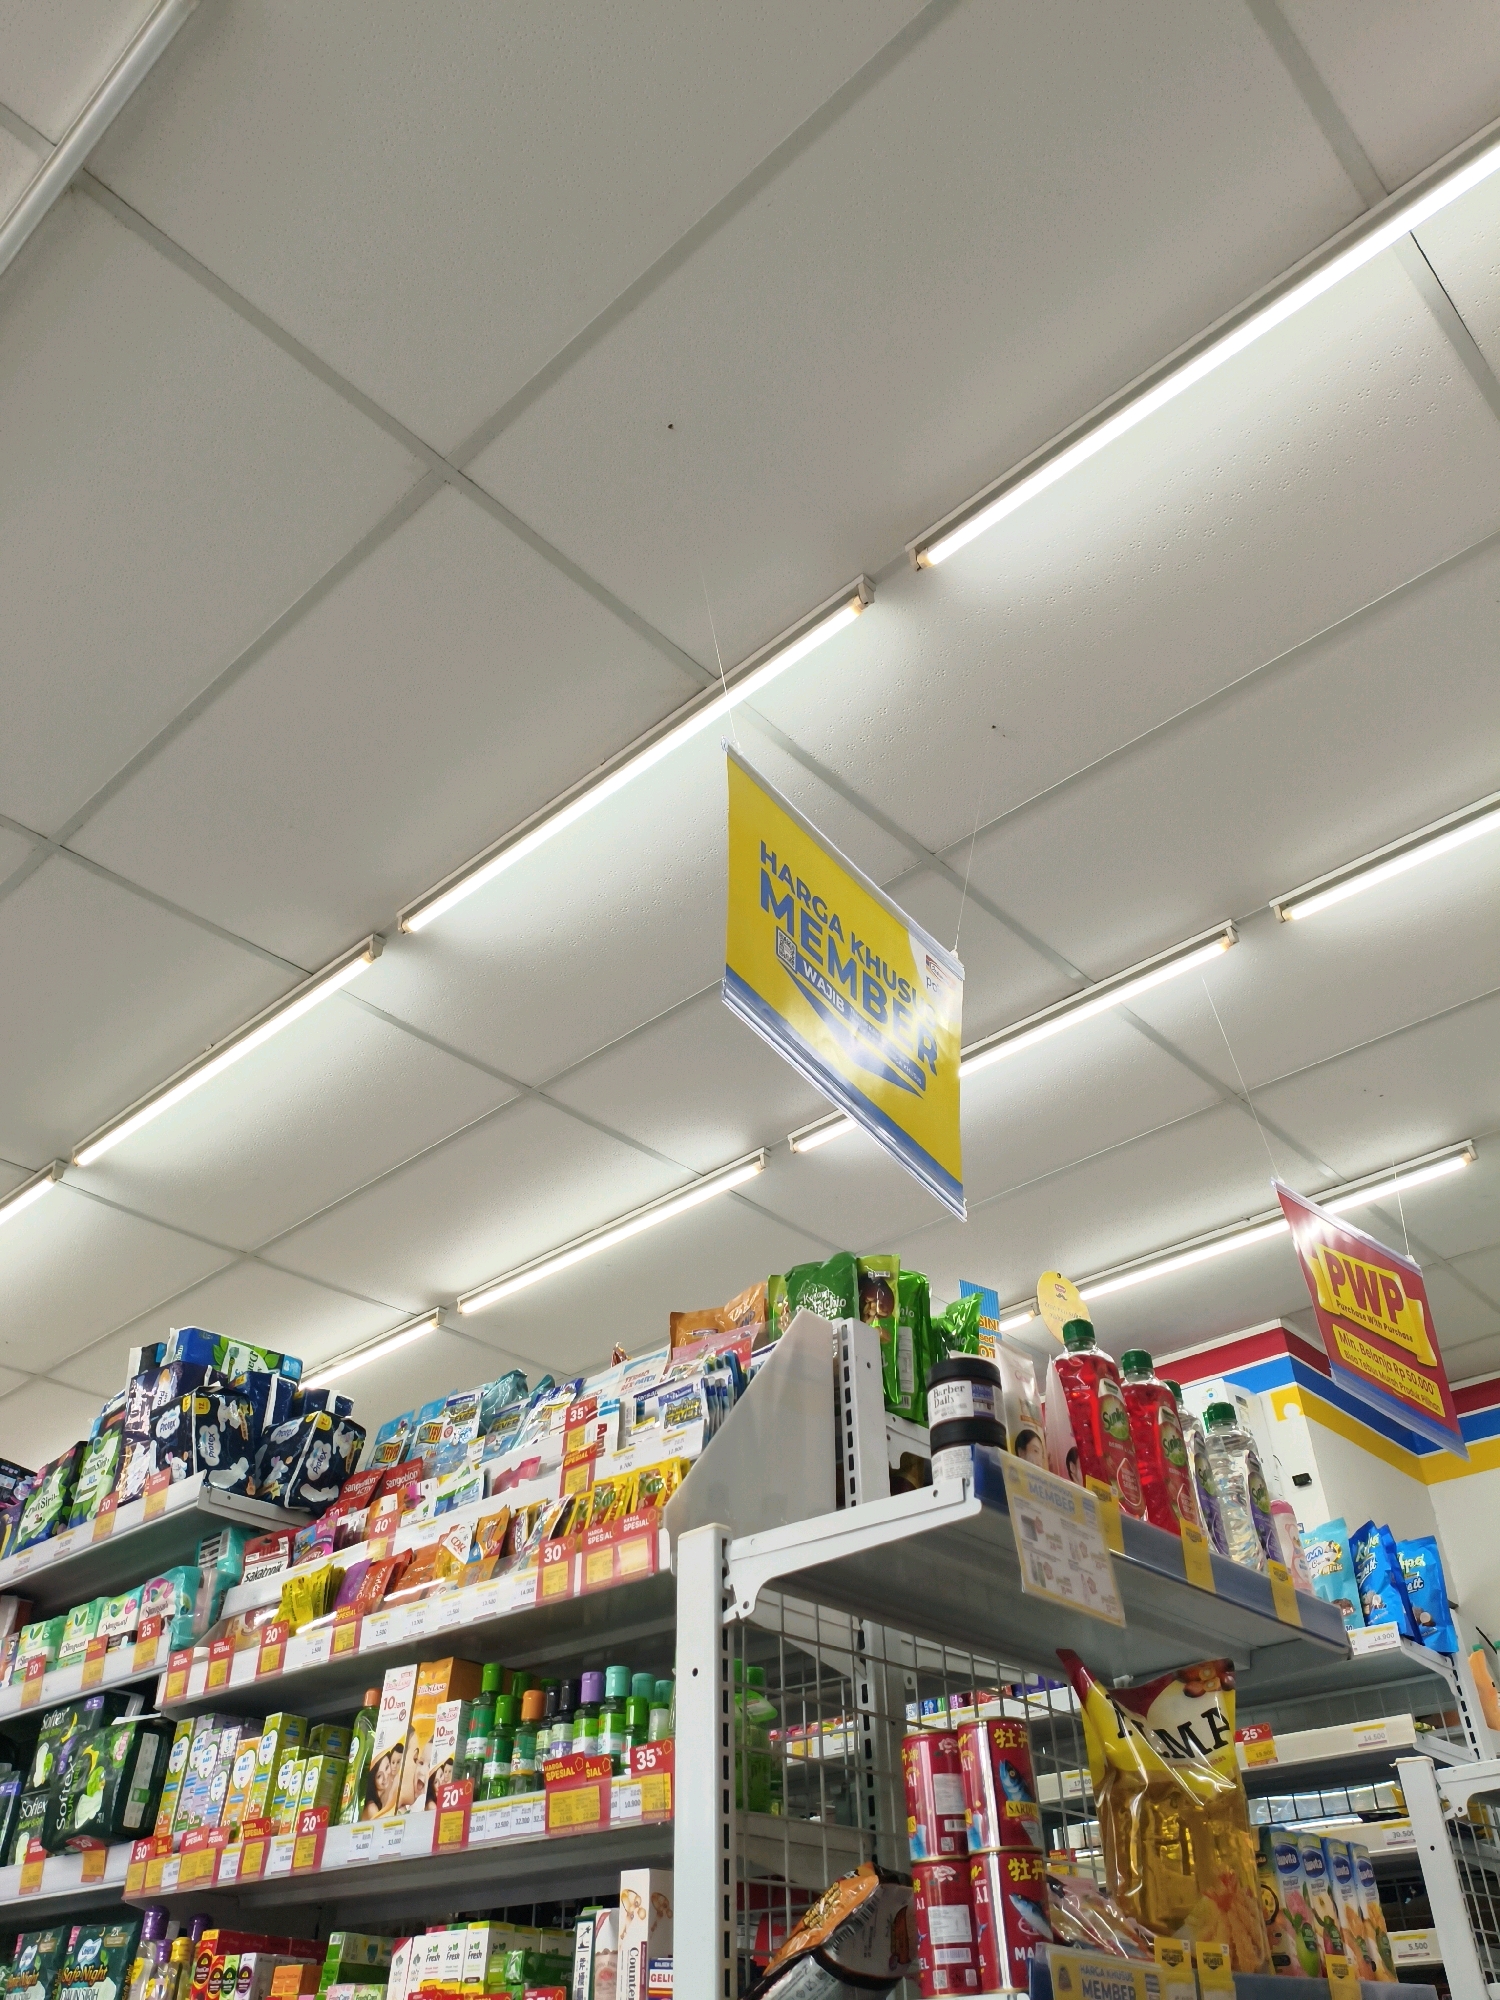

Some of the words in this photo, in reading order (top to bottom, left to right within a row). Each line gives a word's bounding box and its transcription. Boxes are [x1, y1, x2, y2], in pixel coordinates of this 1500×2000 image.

[760, 840, 845, 941] HARGA
[760, 867, 938, 1075] MEMBER
[802, 959, 846, 1013] WAJIB
[1324, 1250, 1404, 1323] PWP
[1336, 1299, 1367, 1320] Purchase
[1367, 1314, 1382, 1330] With
[1383, 1322, 1413, 1343] Purchase
[1338, 1331, 1360, 1353] Min.
[1360, 1342, 1392, 1373] Belanja
[1393, 1362, 1406, 1382] Rp
[1344, 1350, 1358, 1365] Bisa
[933, 1384, 965, 1399] Barber
[208, 1433, 216, 1458] Protex
[312, 1450, 328, 1474] Protex
[1029, 1482, 1075, 1516] MEMBER
[624, 1520, 650, 1532] SPESIAL
[588, 1531, 613, 1545] SPESIAL
[383, 1696, 395, 1711] 10
[41, 1706, 70, 1731] Softex
[436, 1726, 445, 1737] 10
[173, 1749, 184, 1758] BABY
[636, 1747, 663, 1771] 35%
[238, 1763, 250, 1772] BABY
[544, 1762, 563, 1771] HARGA
[545, 1767, 575, 1781] SPESIAL
[56, 1756, 76, 1830] Softex
[208, 1834, 224, 1844] PESIAL
[244, 1827, 265, 1838] SPESIAL
[975, 1886, 989, 1904] A1
[1409, 1942, 1428, 1951] 5.500
[425, 1952, 441, 1963] Fresh
[446, 1951, 460, 1961] Fresh
[468, 1950, 482, 1961] Fresh
[62, 1966, 82, 1982] Safe
[84, 1964, 108, 1983] Night
[1082, 1978, 1136, 2000] MEMBER
